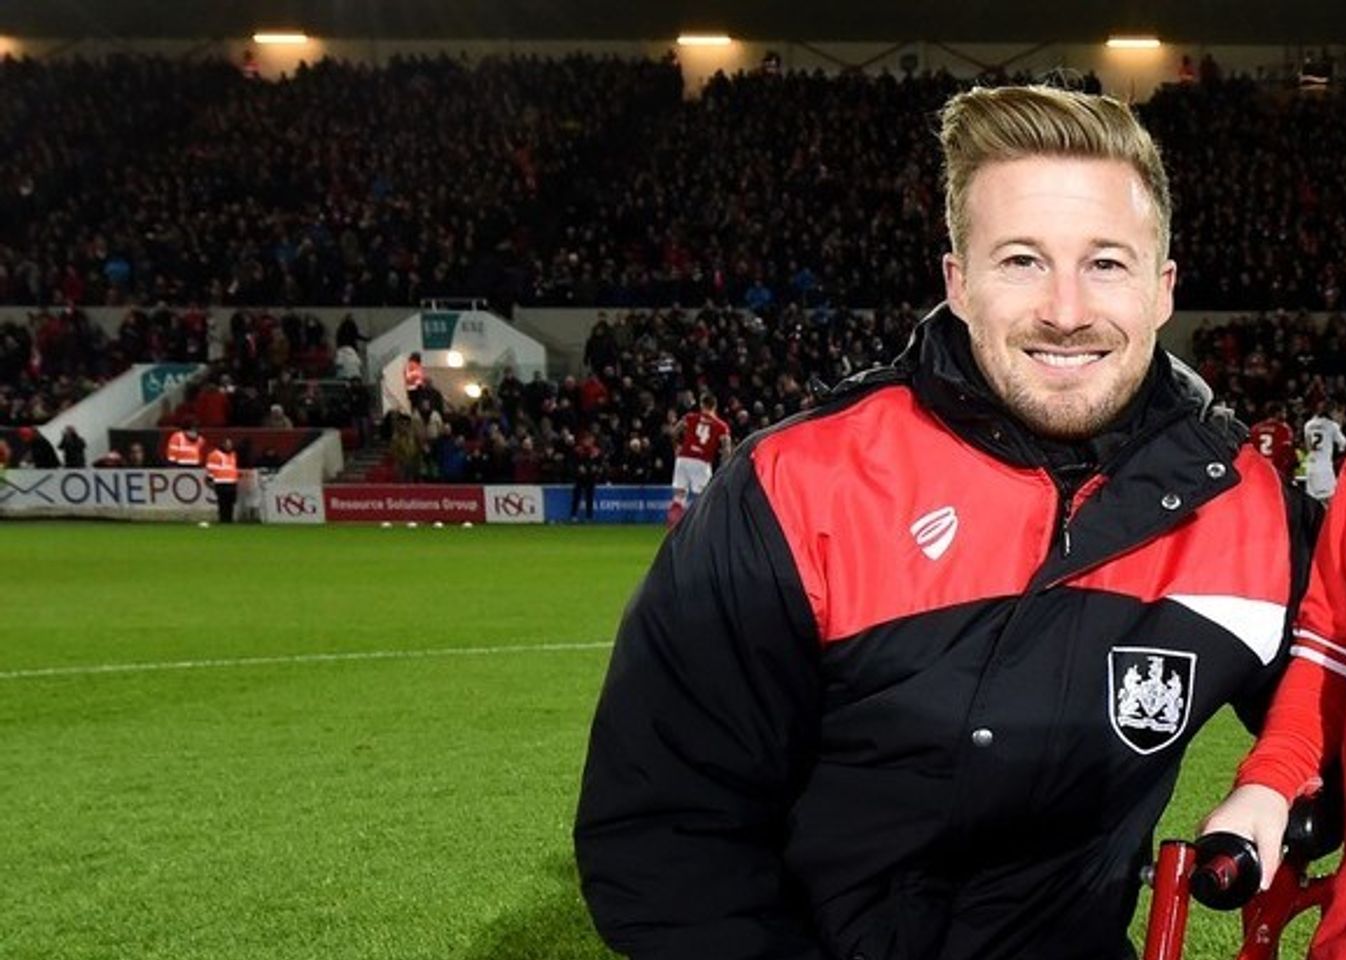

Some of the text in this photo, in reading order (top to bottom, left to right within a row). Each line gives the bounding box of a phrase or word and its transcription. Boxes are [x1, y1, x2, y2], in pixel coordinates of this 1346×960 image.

[1259, 433, 1273, 456] 2
[275, 492, 317, 517] RSG
[330, 497, 478, 512] Resource Solutions Group
[494, 492, 536, 517] RSG
